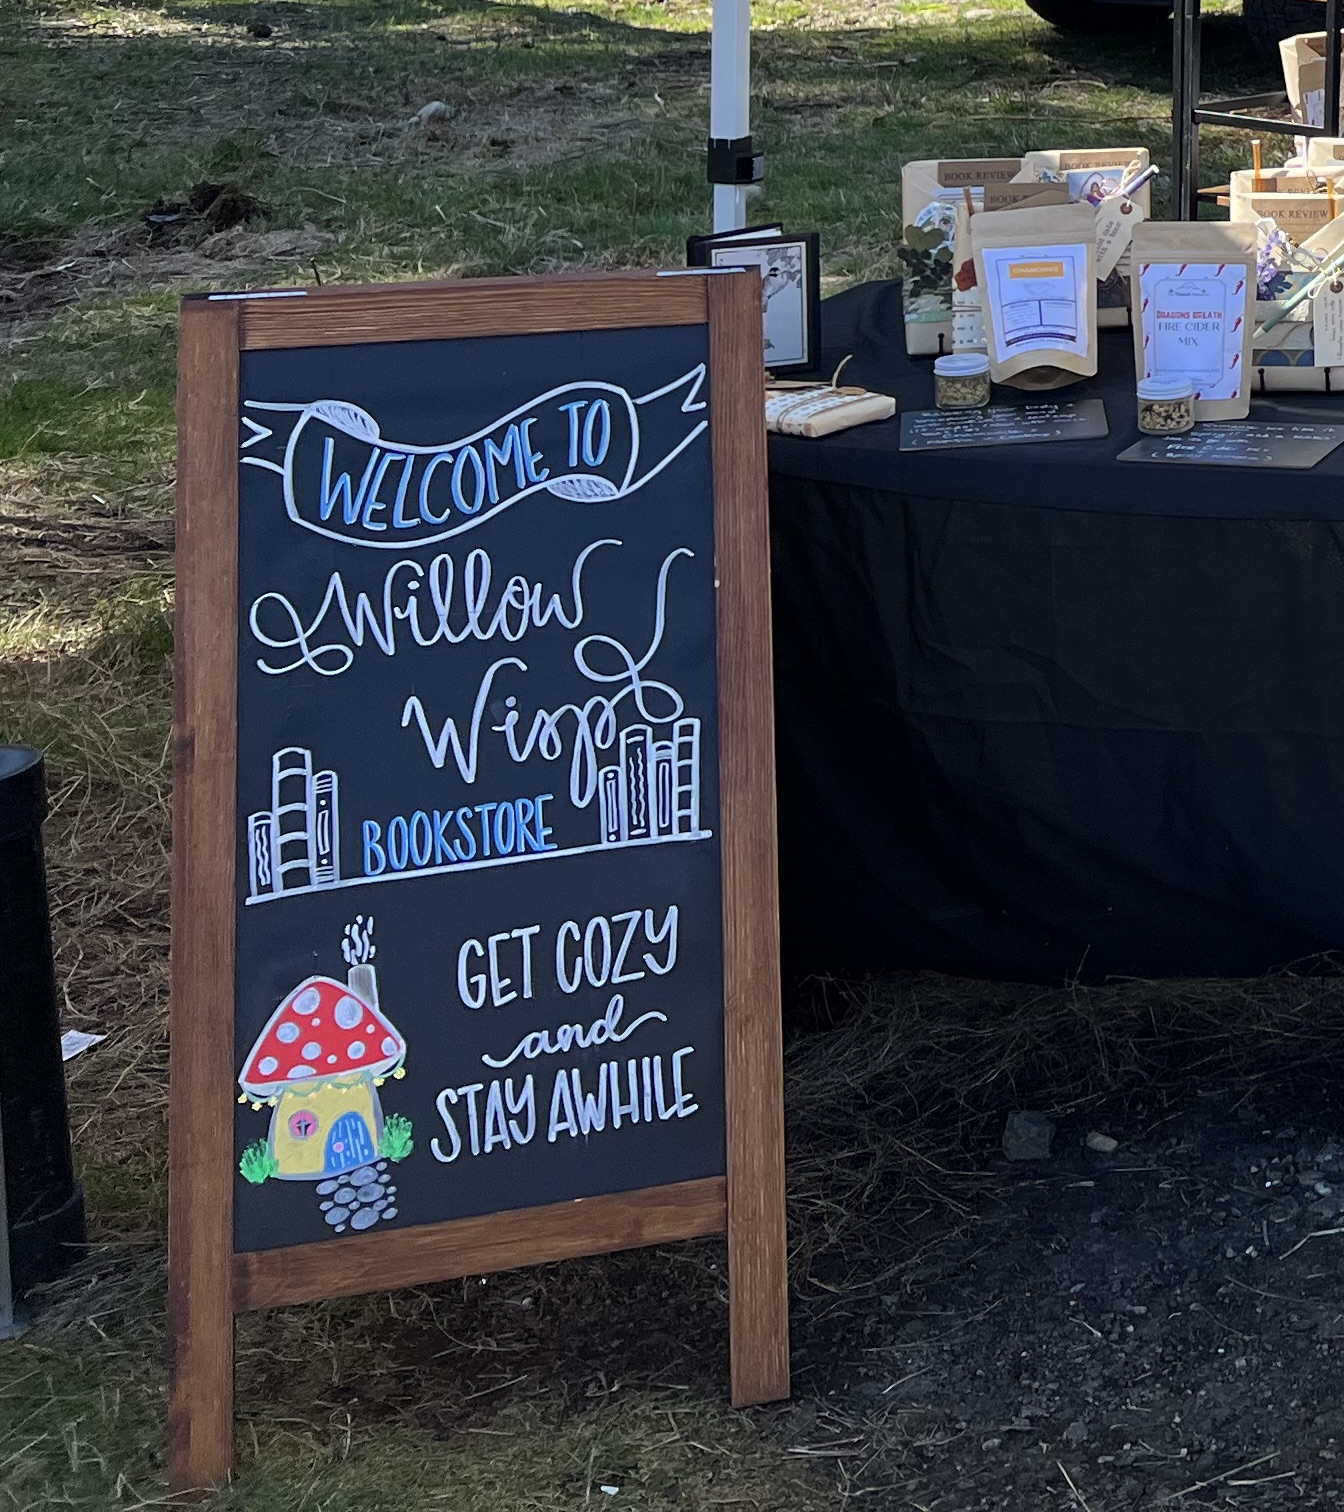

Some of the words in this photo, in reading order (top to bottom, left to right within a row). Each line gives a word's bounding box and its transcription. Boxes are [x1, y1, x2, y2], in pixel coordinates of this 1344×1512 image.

[944, 171, 974, 181] BOOK
[990, 194, 1019, 204] BOOK
[1288, 209, 1329, 220] REVIEW
[1156, 310, 1190, 320] DRAGONS
[1192, 310, 1223, 320] BREATH
[1158, 322, 1181, 332] FIRE
[1184, 322, 1220, 332] CIDER
[1178, 337, 1198, 346] MIX
[319, 417, 550, 531] WELCOME
[558, 399, 612, 467] TO
[249, 540, 623, 676] Willow
[362, 794, 558, 876] BOOKSTORE
[456, 925, 540, 1010] GET
[555, 905, 680, 994] COZY
[481, 994, 667, 1069] and
[431, 1073, 535, 1164] STAY
